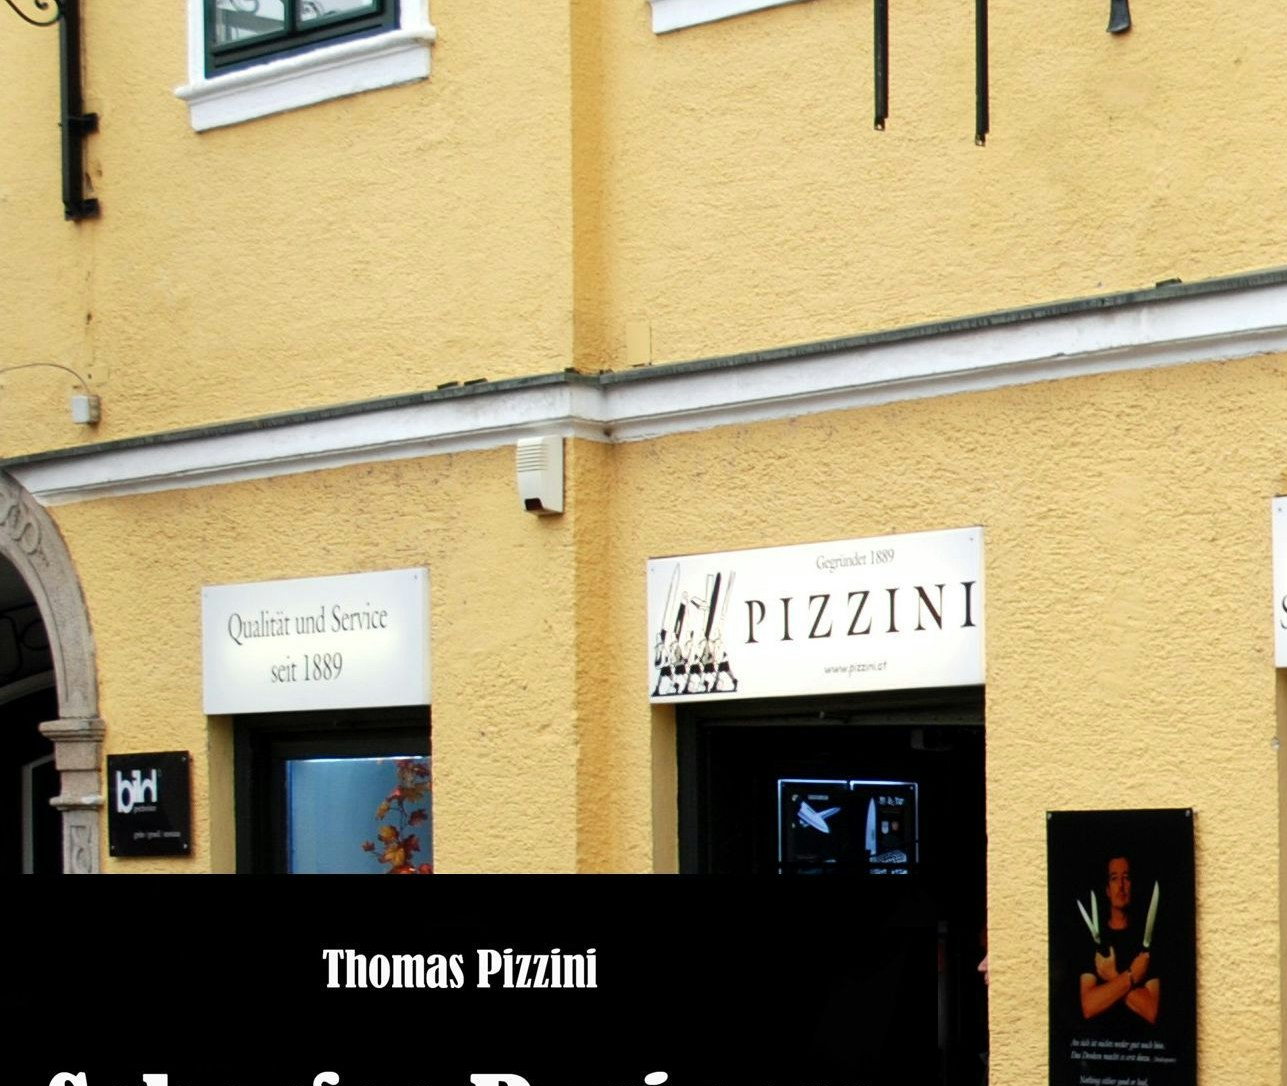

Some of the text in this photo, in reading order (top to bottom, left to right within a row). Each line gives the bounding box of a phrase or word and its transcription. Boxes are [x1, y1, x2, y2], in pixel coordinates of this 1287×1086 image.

[816, 548, 895, 573] Gegründet 1889
[227, 601, 389, 647] Qualität und Service
[745, 581, 977, 644] PIZZINI
[270, 651, 344, 684] seit 1889
